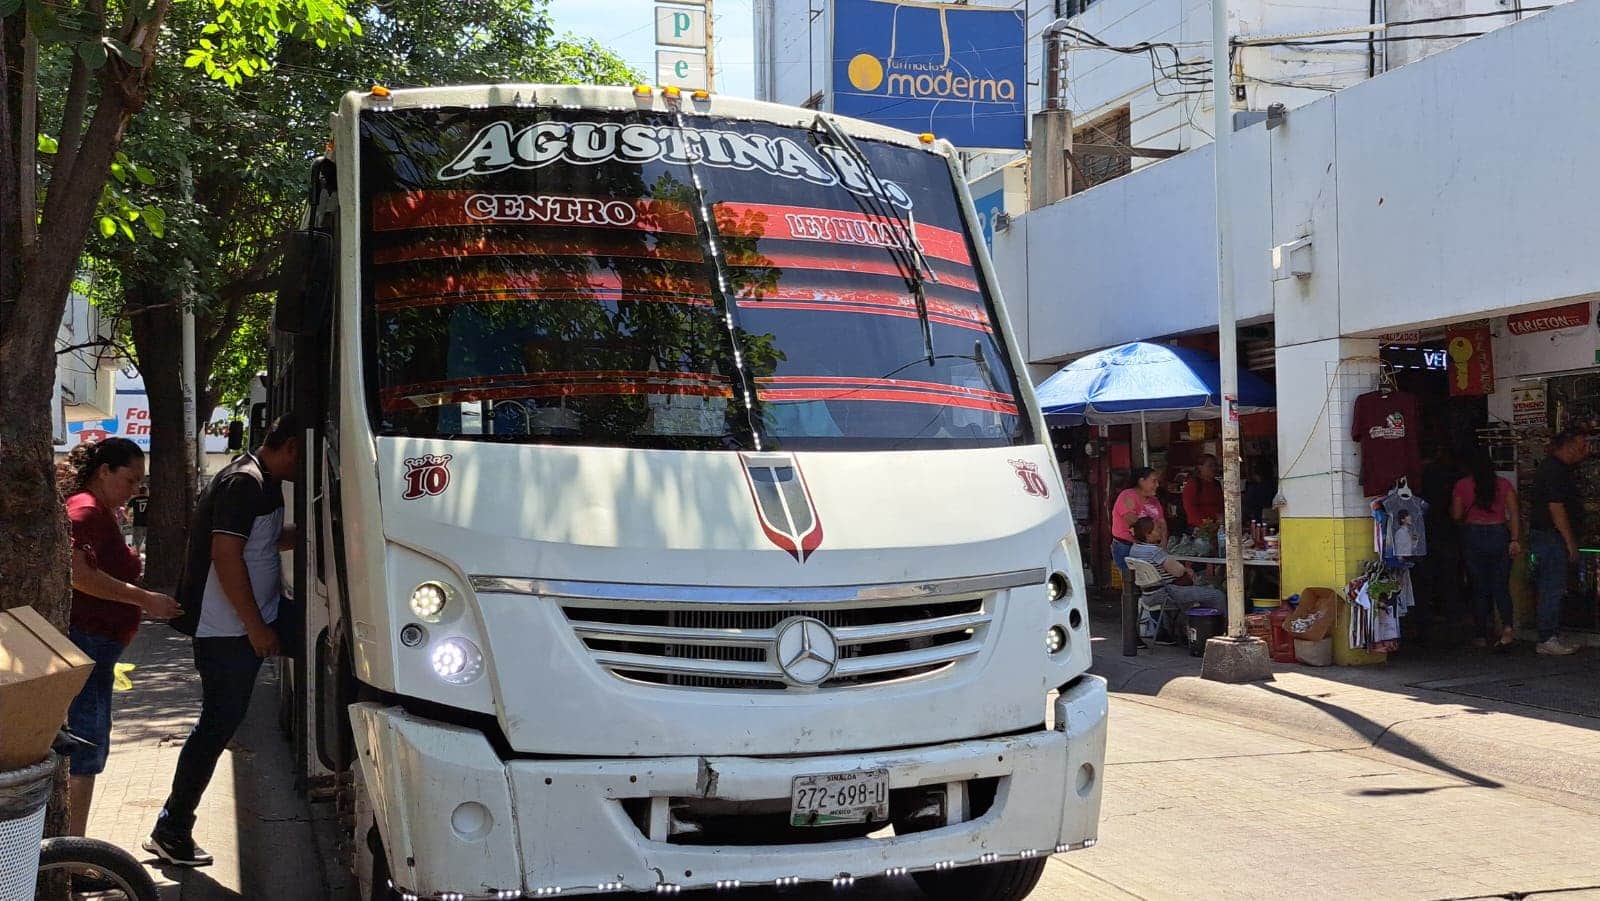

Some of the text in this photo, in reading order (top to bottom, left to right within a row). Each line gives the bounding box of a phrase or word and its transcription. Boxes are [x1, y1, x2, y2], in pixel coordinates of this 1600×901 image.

[887, 71, 1015, 101] moderna
[437, 121, 837, 187] AGUSTINA
[464, 193, 636, 226] CENTRO
[785, 214, 834, 240] LEY
[402, 465, 450, 500] 10
[1015, 469, 1049, 499] 10
[797, 782, 885, 809] 272-698-U
